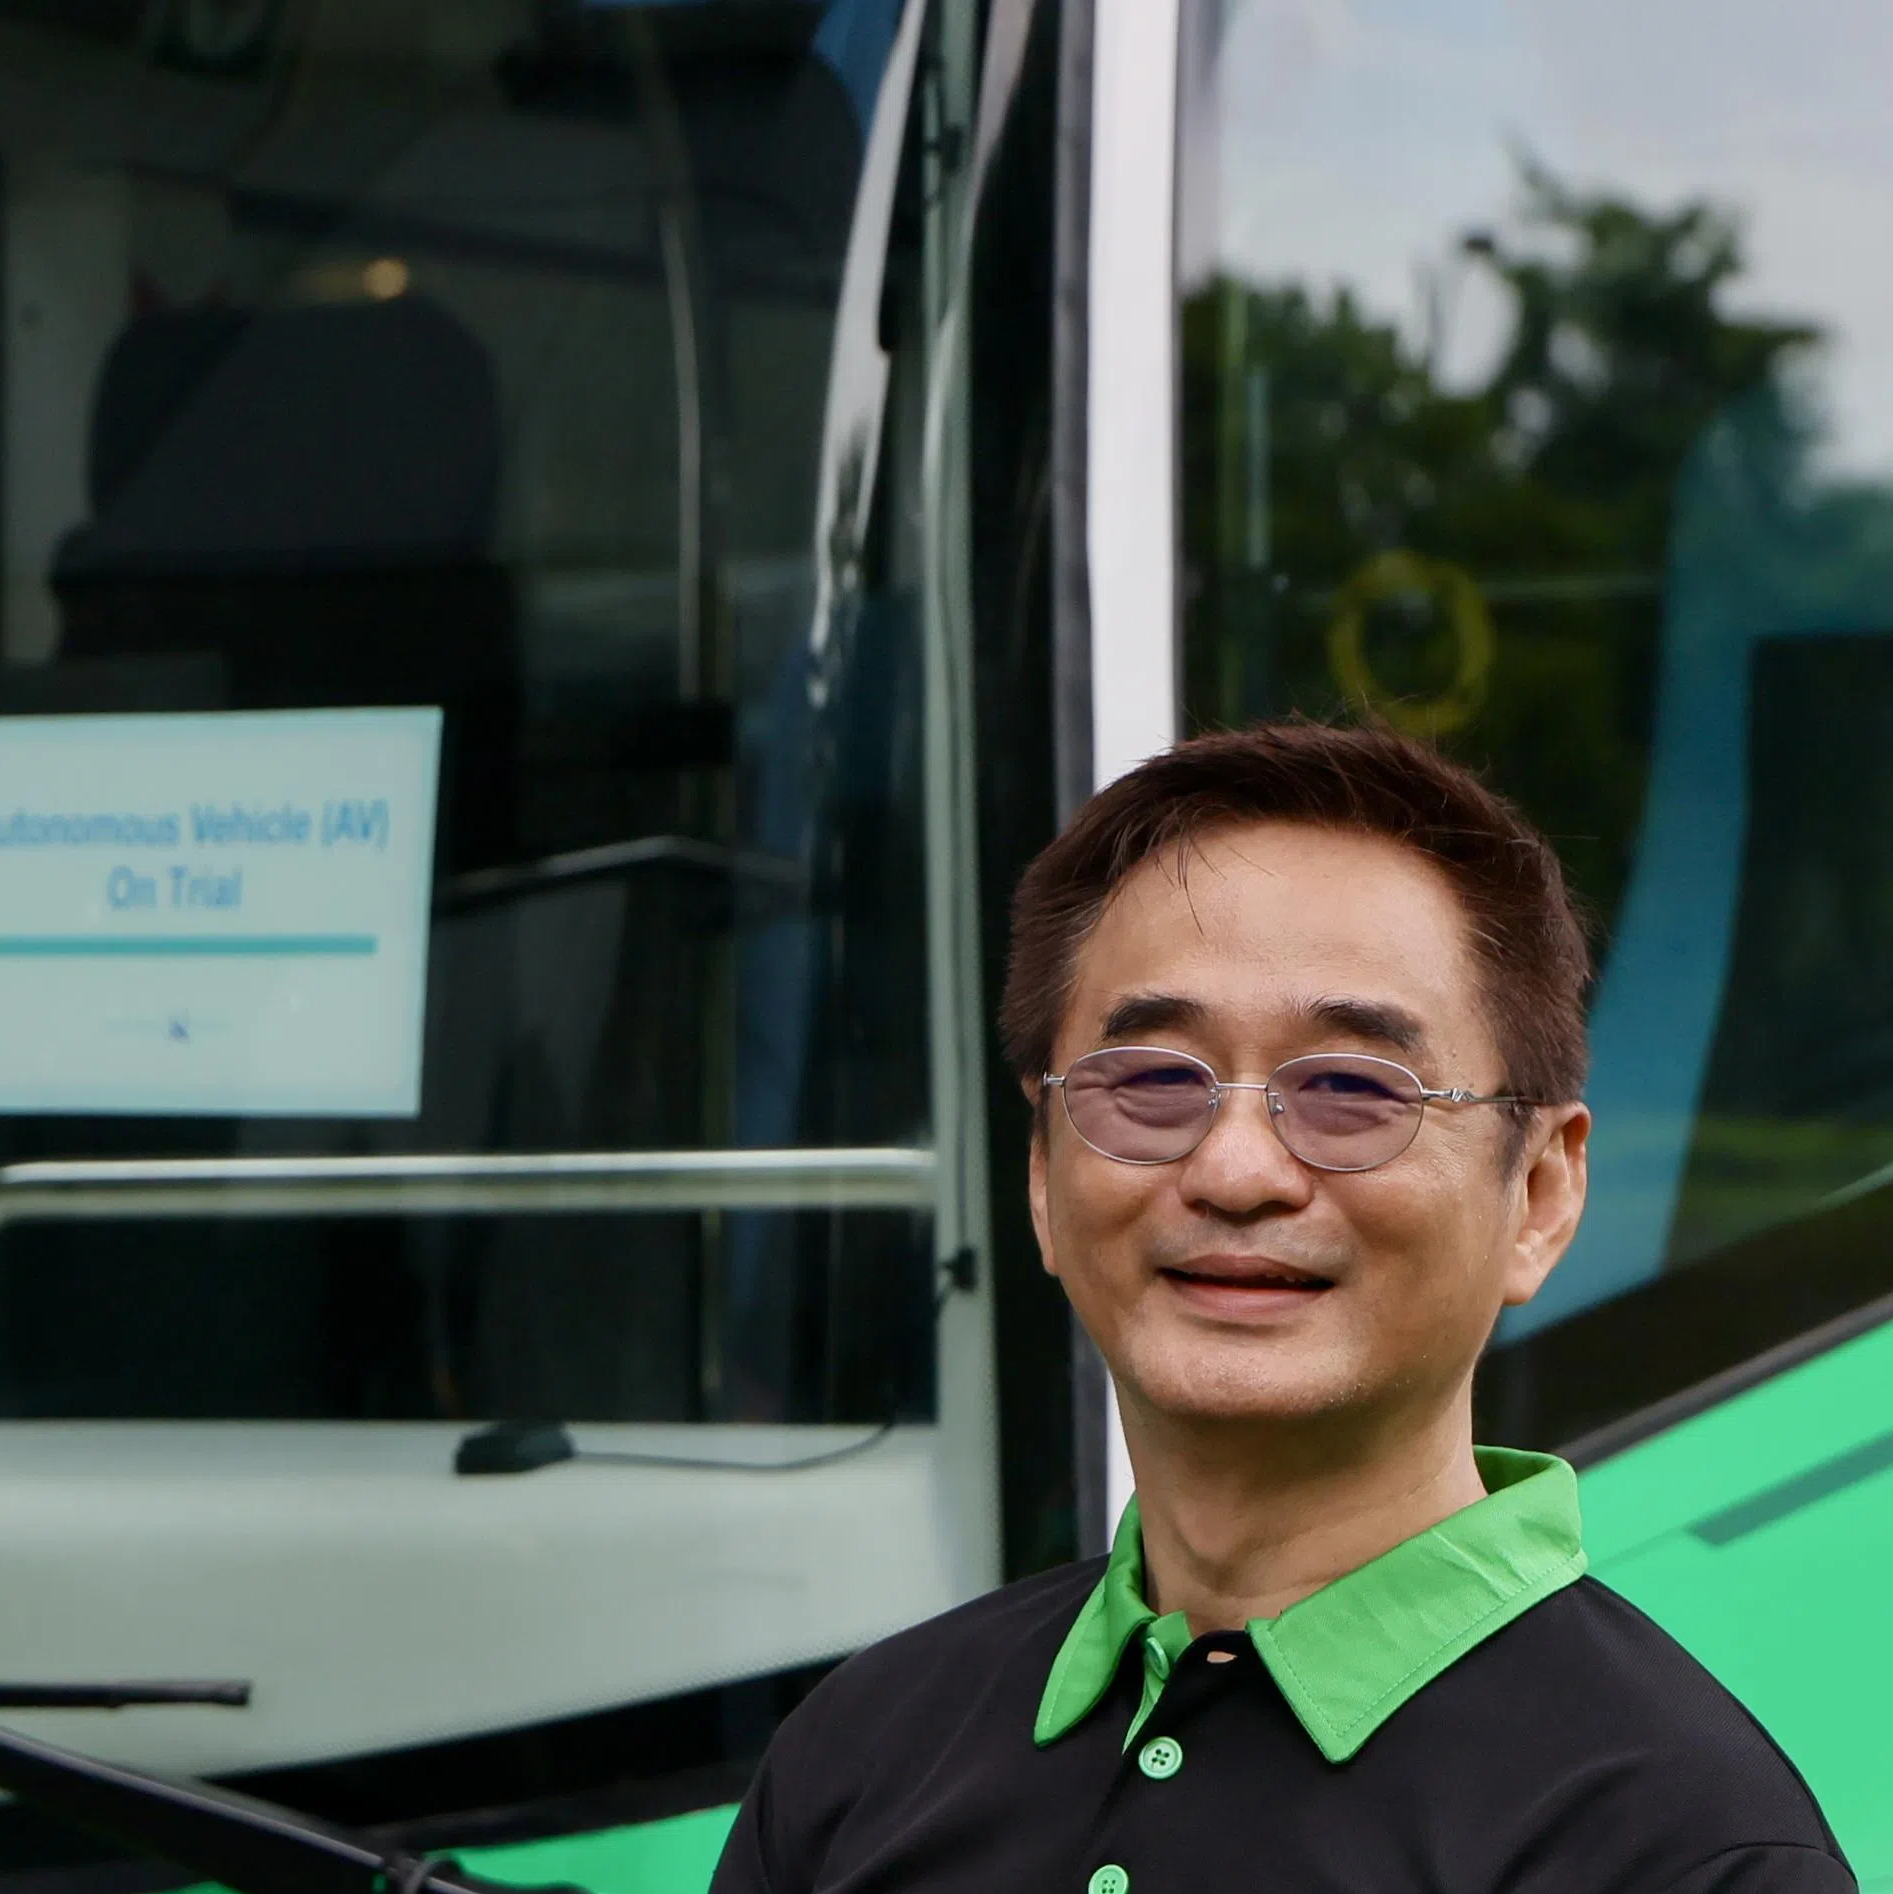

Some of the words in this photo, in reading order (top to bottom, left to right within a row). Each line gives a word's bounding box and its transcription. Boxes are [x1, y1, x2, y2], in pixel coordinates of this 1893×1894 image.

[191, 804, 312, 845] Vehicle
[321, 799, 390, 849] (AV)
[107, 867, 157, 909] On
[166, 865, 244, 908] Trial
